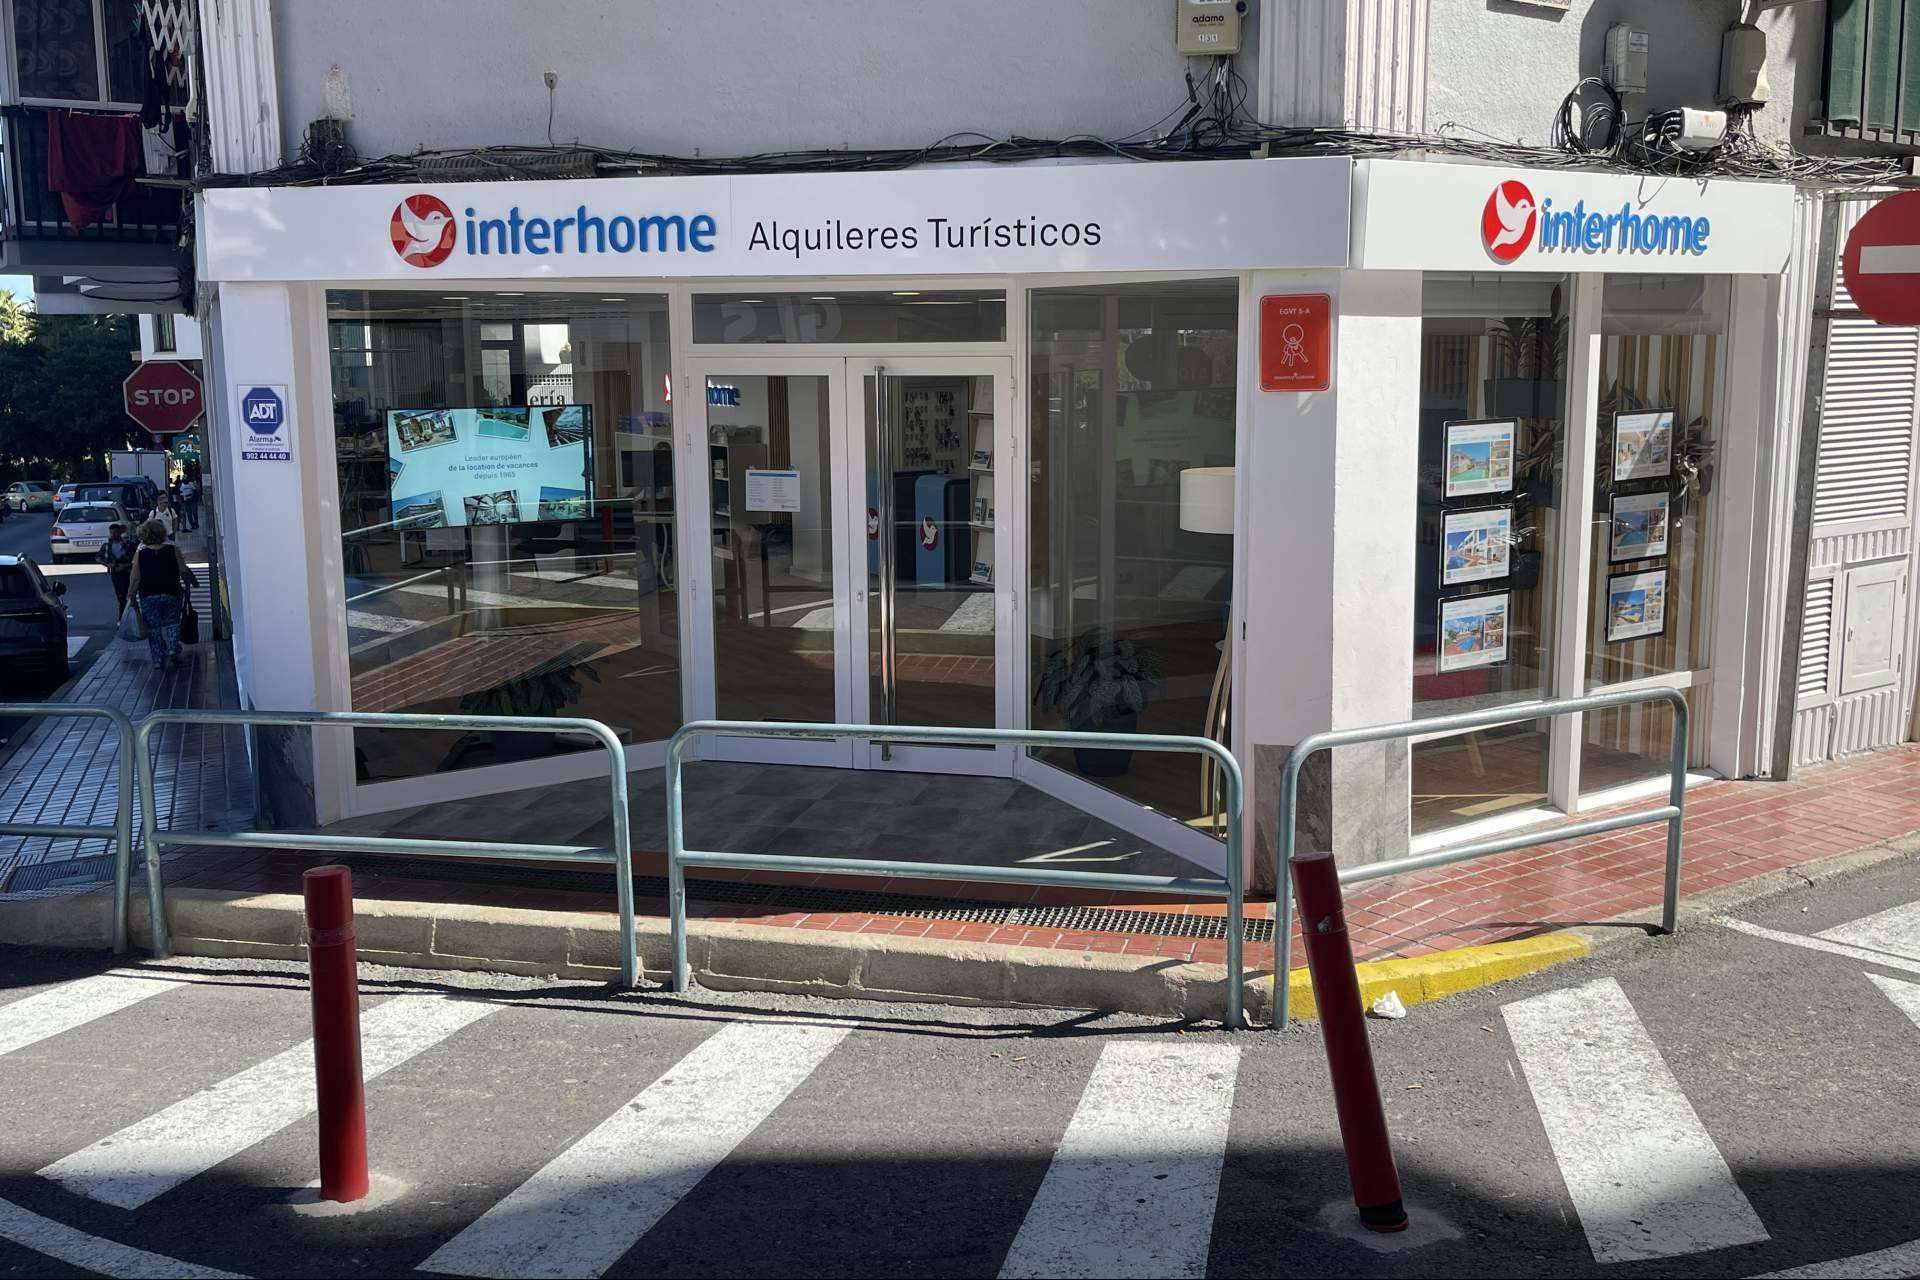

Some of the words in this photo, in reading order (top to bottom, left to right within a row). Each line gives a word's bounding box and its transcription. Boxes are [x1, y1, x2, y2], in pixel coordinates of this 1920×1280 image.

[1192, 14, 1224, 23] adamo
[464, 205, 717, 255] interhome
[1540, 197, 1710, 253] interhome
[748, 219, 919, 259] Alquileres
[927, 215, 1102, 249] Turísticos
[1279, 307, 1297, 315] EGVT
[134, 388, 195, 405] STOP
[250, 403, 276, 419] ADT
[448, 463, 458, 472] de
[458, 463, 466, 471] la
[467, 462, 495, 471] location
[497, 462, 505, 470] de
[506, 461, 538, 469] vacances
[473, 472, 498, 480] depuis
